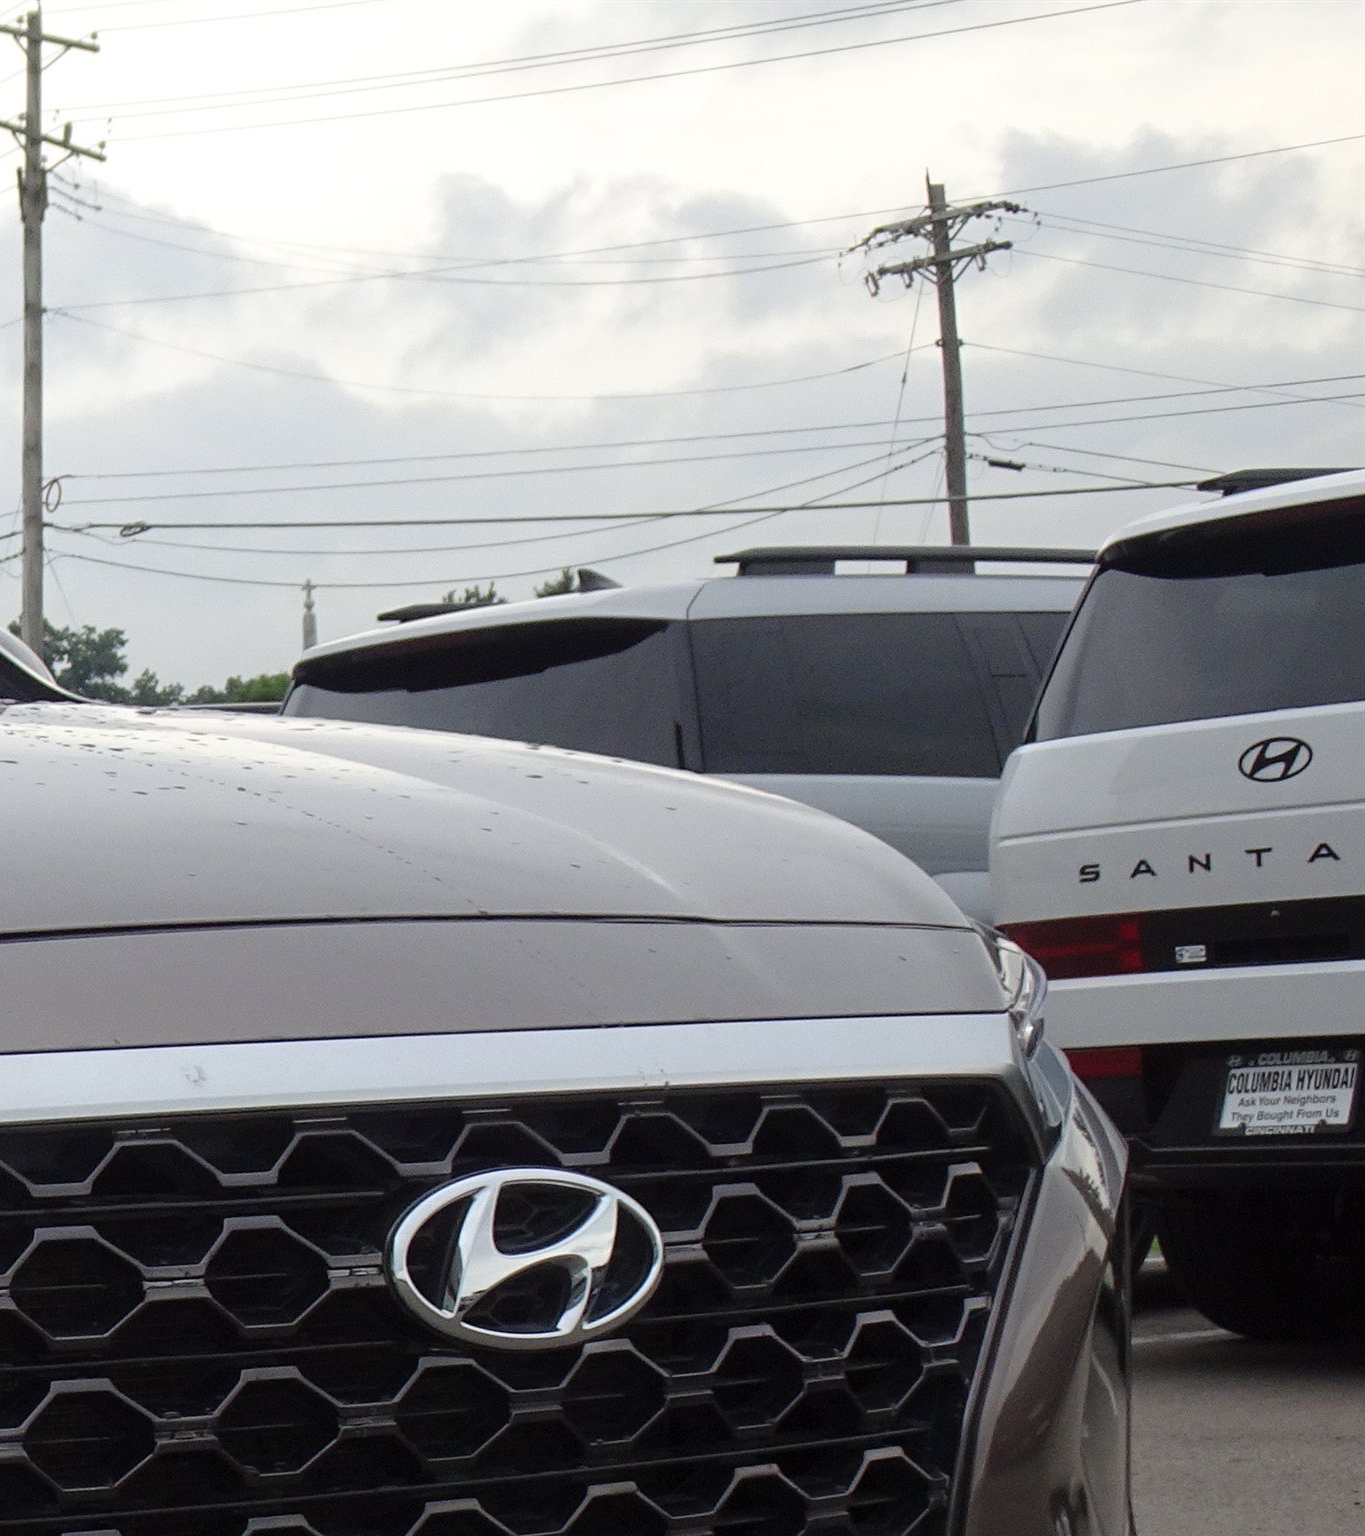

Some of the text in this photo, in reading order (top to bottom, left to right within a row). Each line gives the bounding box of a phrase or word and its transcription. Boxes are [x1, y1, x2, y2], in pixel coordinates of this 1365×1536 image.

[1079, 843, 1341, 883] SANTA
[1258, 1050, 1329, 1065] COLUMBIA
[1228, 1067, 1355, 1094] COLUMBIA HYUNDAI
[1238, 1093, 1336, 1107] Ask Your Neighbors
[1231, 1108, 1340, 1123] They Bought From Us
[1245, 1125, 1315, 1135] CINCINNATI
